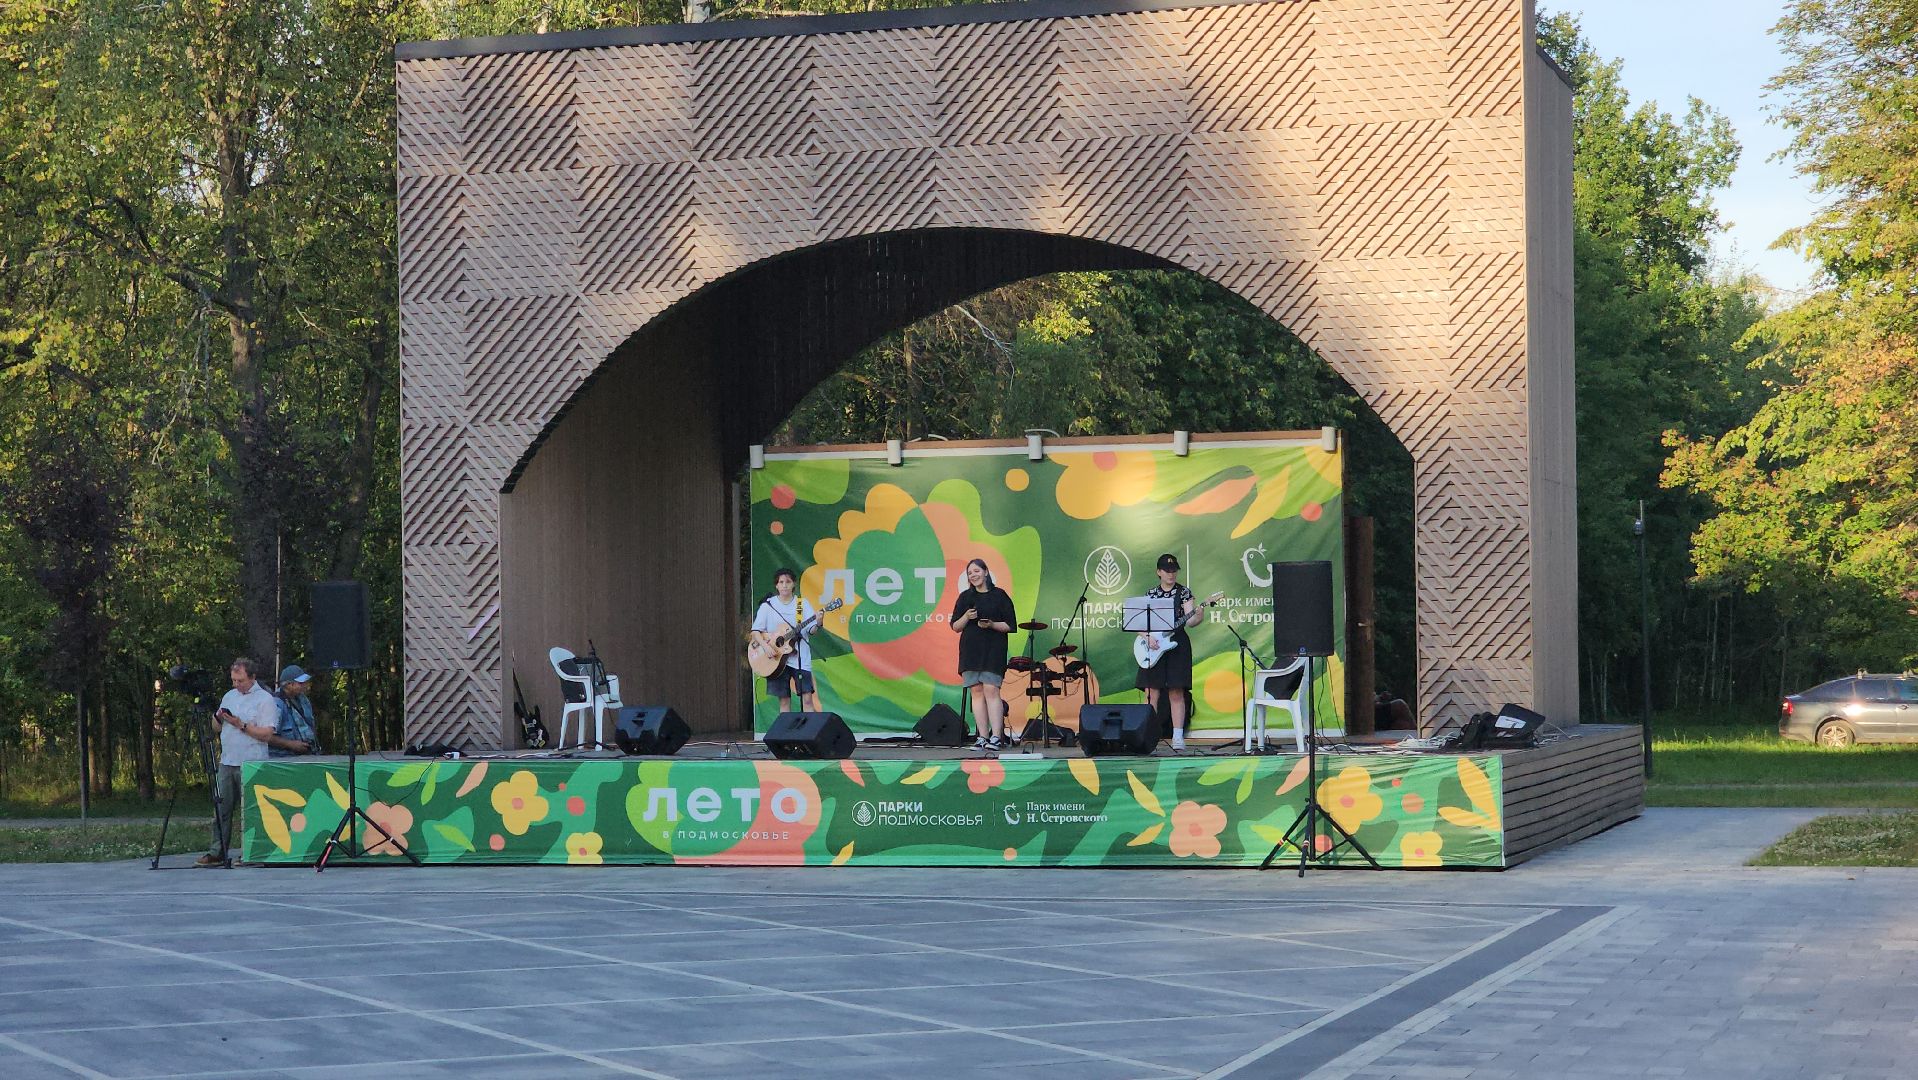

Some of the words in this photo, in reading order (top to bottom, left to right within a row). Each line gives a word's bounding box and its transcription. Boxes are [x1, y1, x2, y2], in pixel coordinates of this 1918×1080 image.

[1215, 597, 1242, 610] арк
[1209, 610, 1226, 624] Н.
[642, 787, 807, 823] лето
[878, 801, 923, 813] ПАРКИ
[1026, 801, 1051, 813] Парк
[1053, 803, 1085, 811] имени
[878, 814, 983, 826] ПОДМОСКОВЬЯ
[1026, 813, 1039, 823] Н.
[1040, 812, 1108, 825] Островского
[678, 830, 790, 841] ПОДМОСКОВЬЕ
